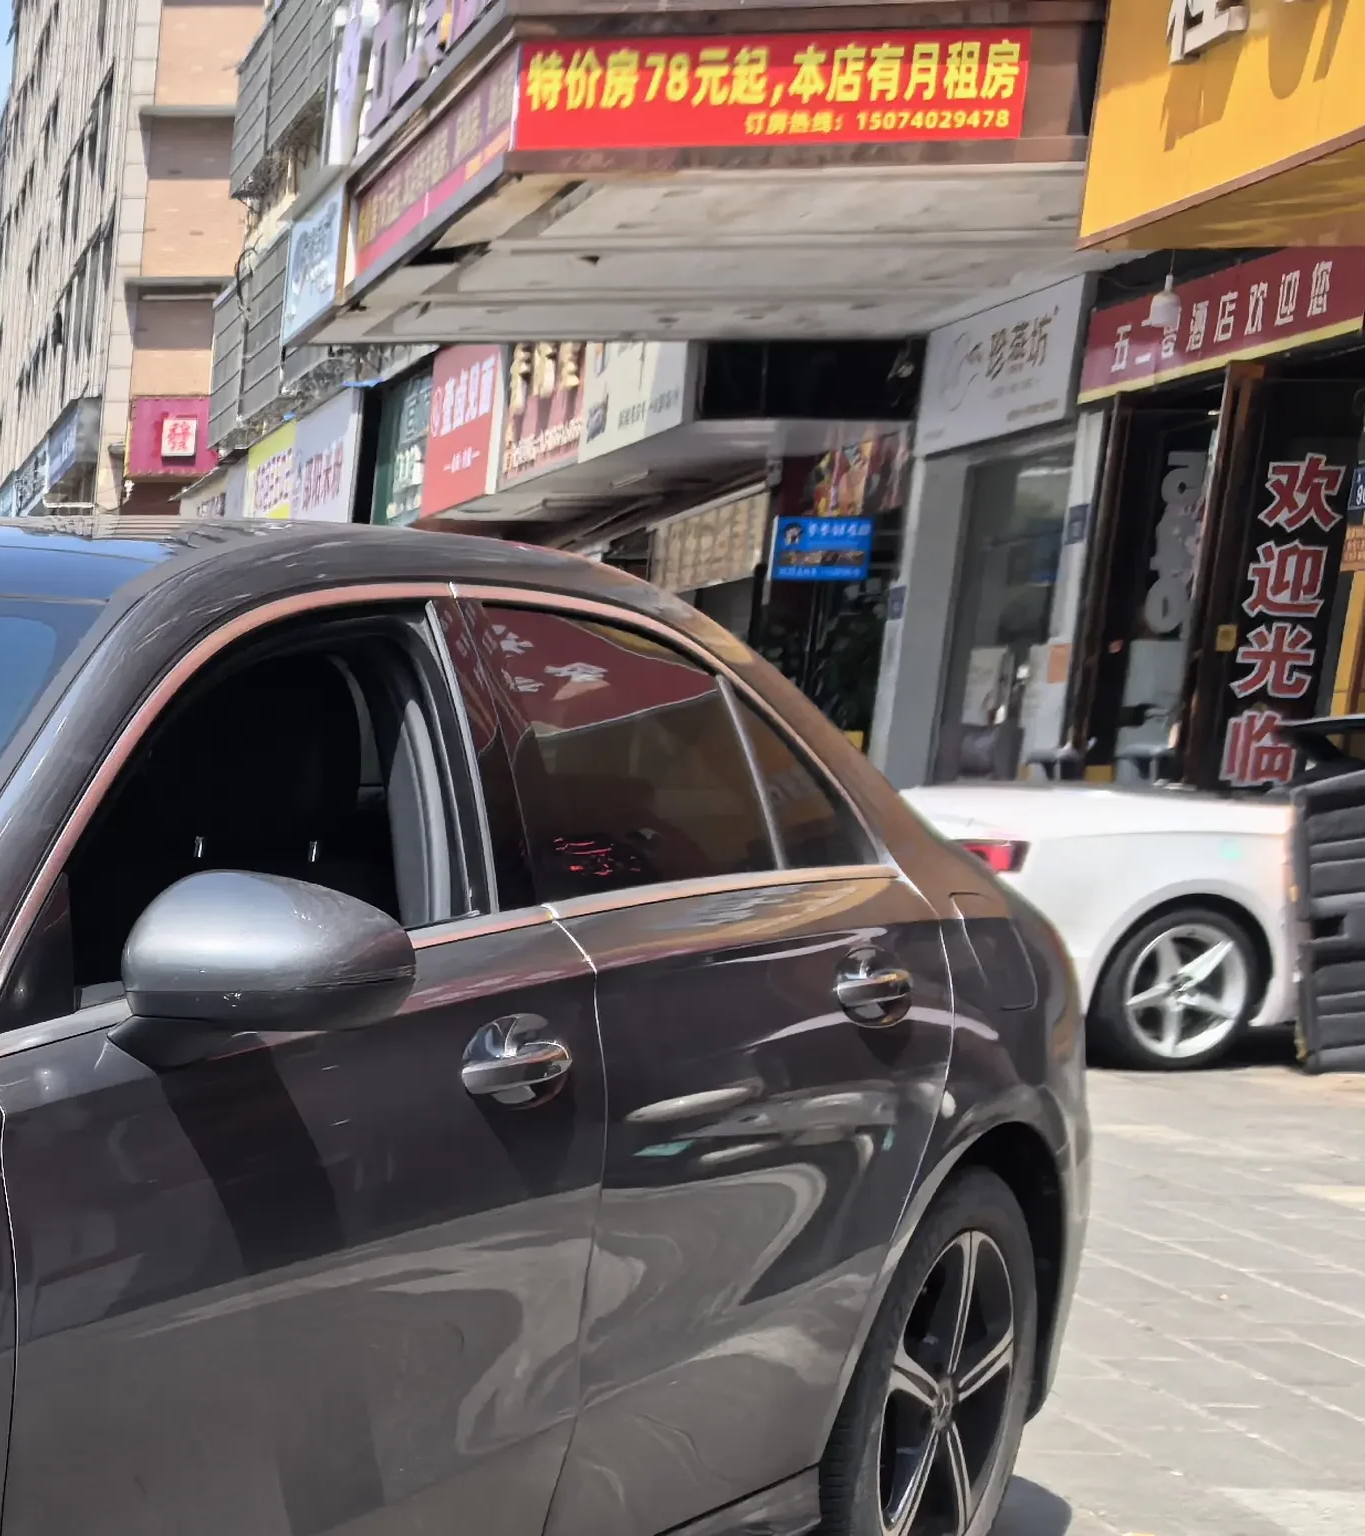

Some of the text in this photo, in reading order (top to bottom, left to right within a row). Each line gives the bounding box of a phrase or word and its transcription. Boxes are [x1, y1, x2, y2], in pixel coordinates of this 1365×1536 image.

[855, 109, 1010, 131] 15074029478
[1219, 453, 1347, 788] 欢迎光临
